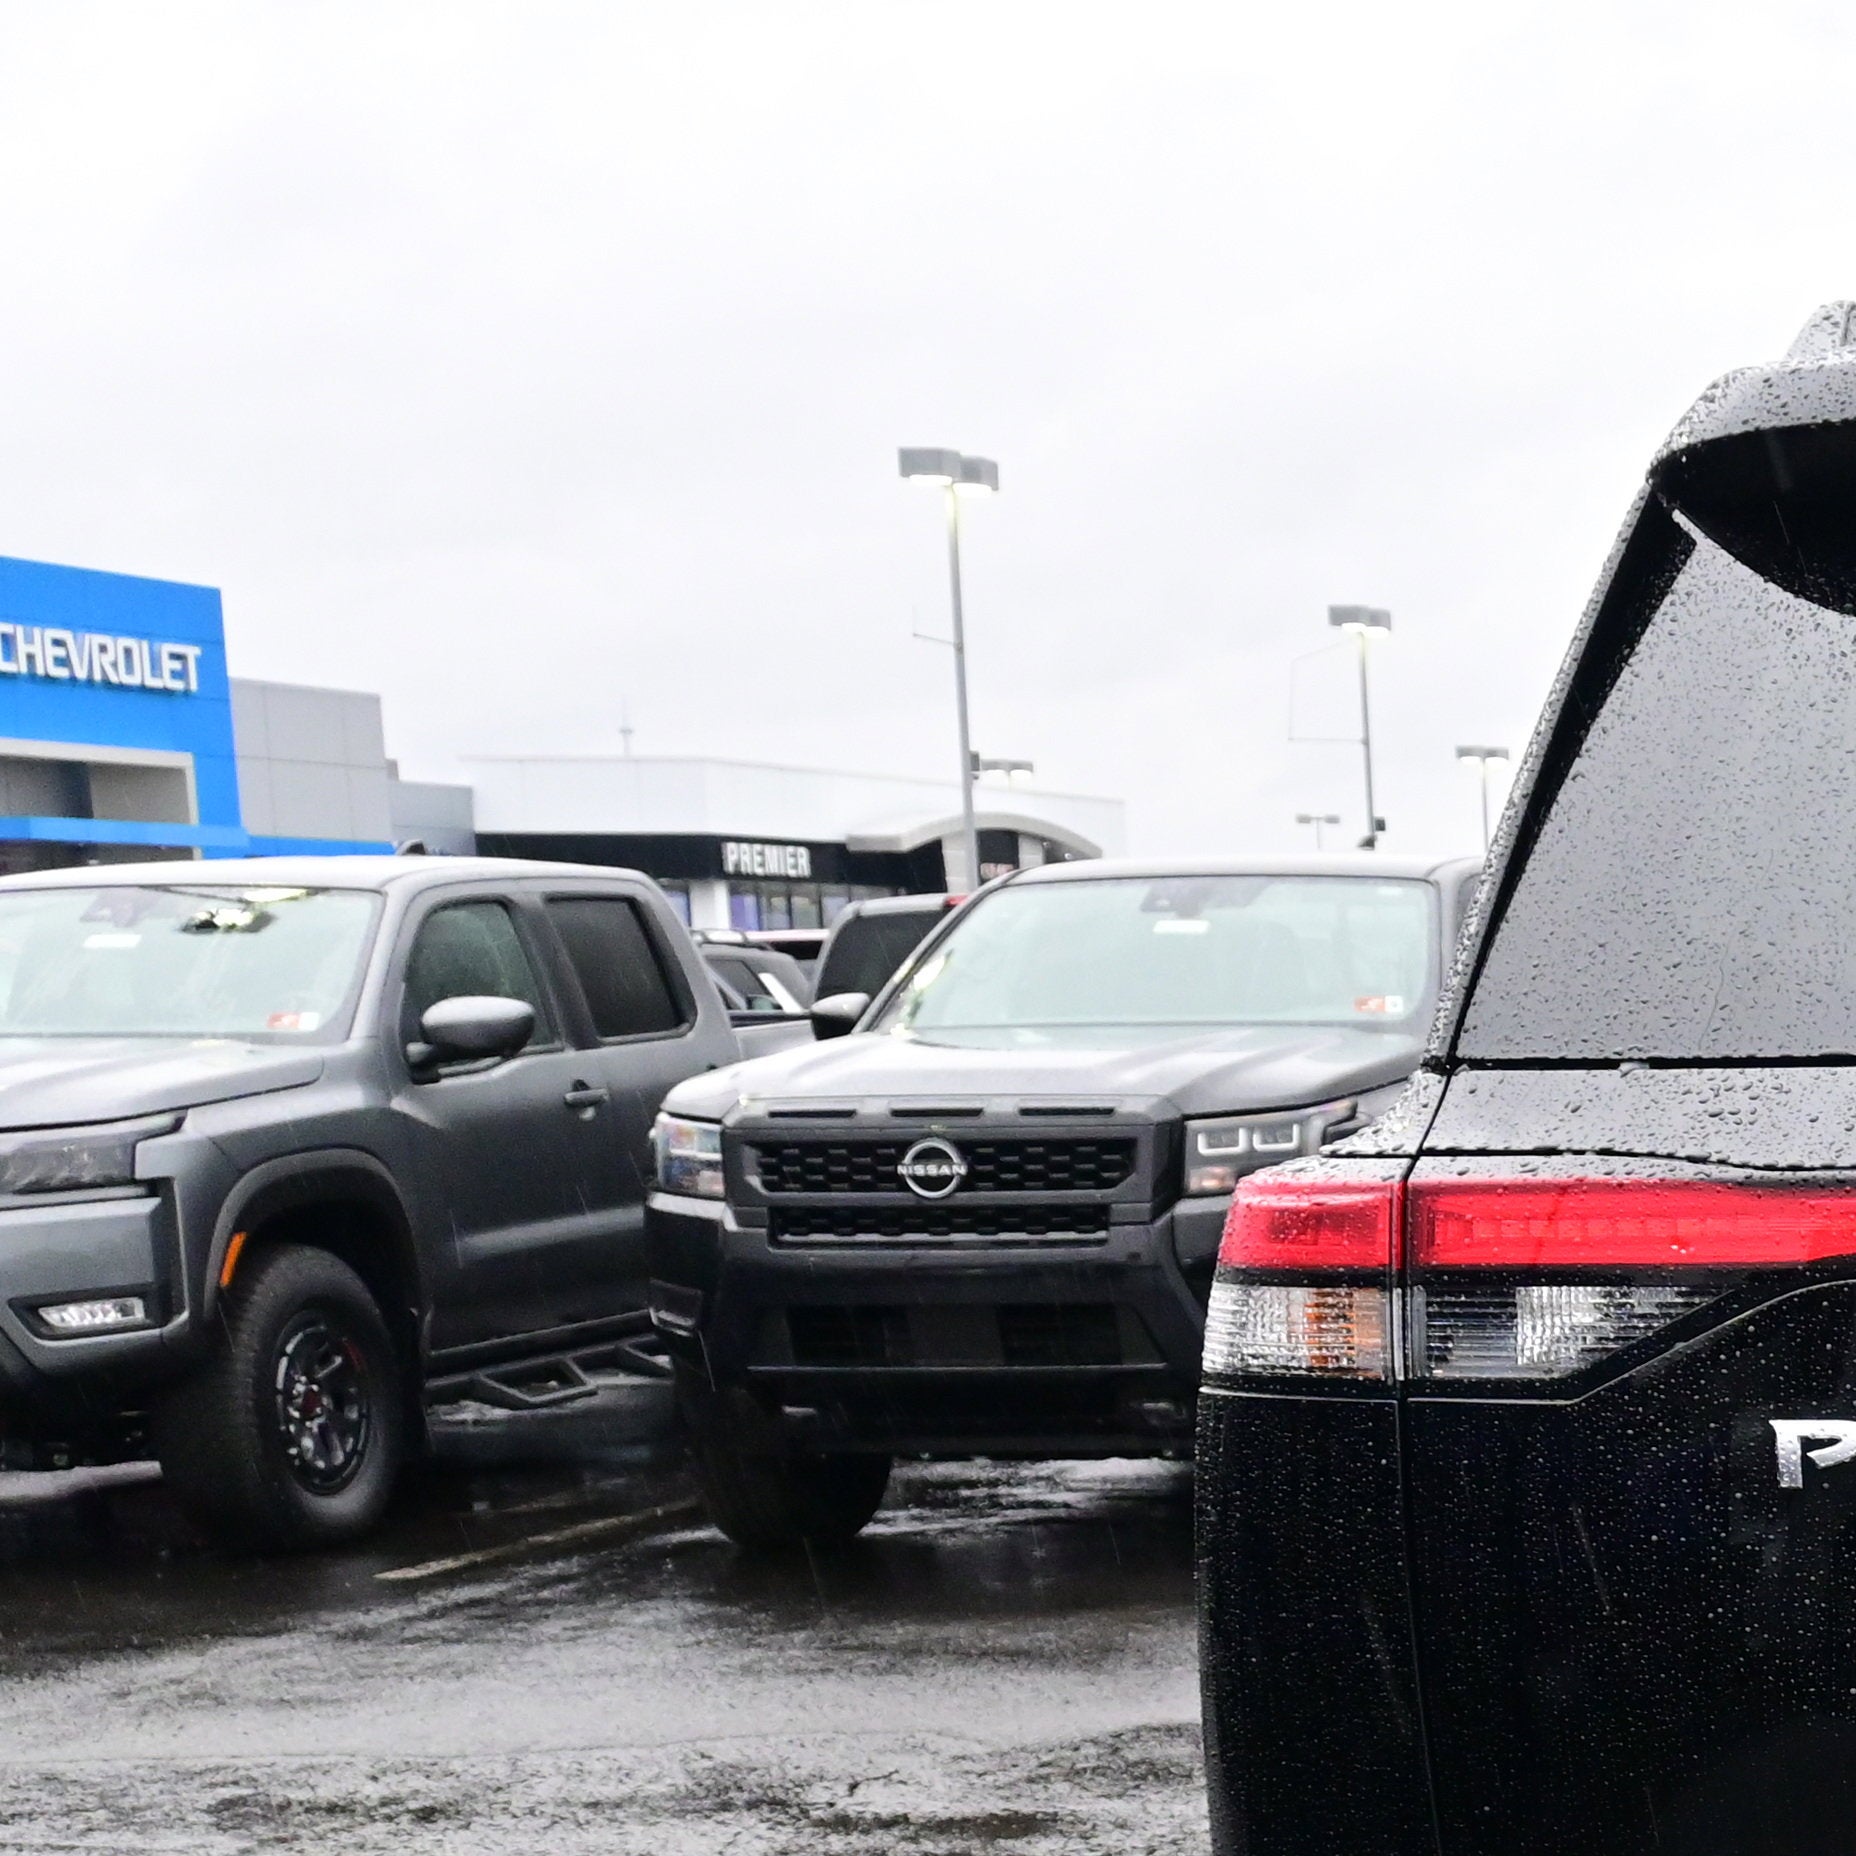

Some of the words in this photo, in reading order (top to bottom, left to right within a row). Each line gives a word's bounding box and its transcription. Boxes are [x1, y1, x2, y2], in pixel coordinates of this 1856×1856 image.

[0, 621, 202, 692] CHEVROLET
[722, 841, 811, 878] PREMIER
[897, 1164, 967, 1177] NISSAN
